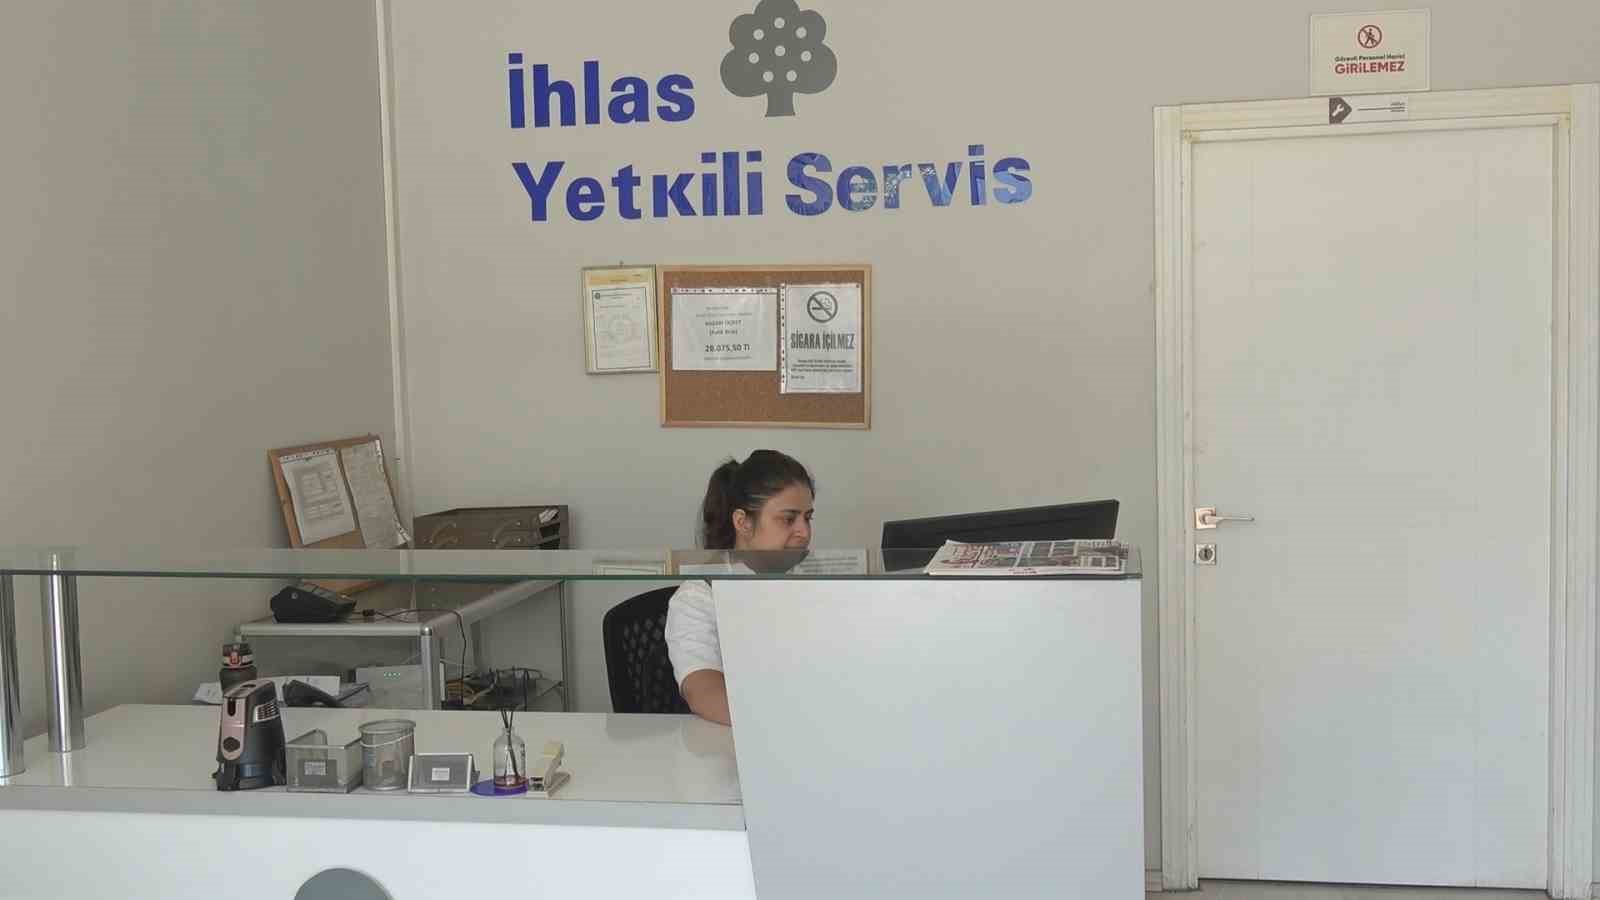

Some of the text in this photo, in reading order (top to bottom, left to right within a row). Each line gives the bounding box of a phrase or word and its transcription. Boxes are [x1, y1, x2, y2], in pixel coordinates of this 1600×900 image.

[508, 53, 695, 128] İhlas
[512, 145, 1033, 221] Yetkili Servis
[790, 329, 855, 351] SİGARA İÇİLMEZ
